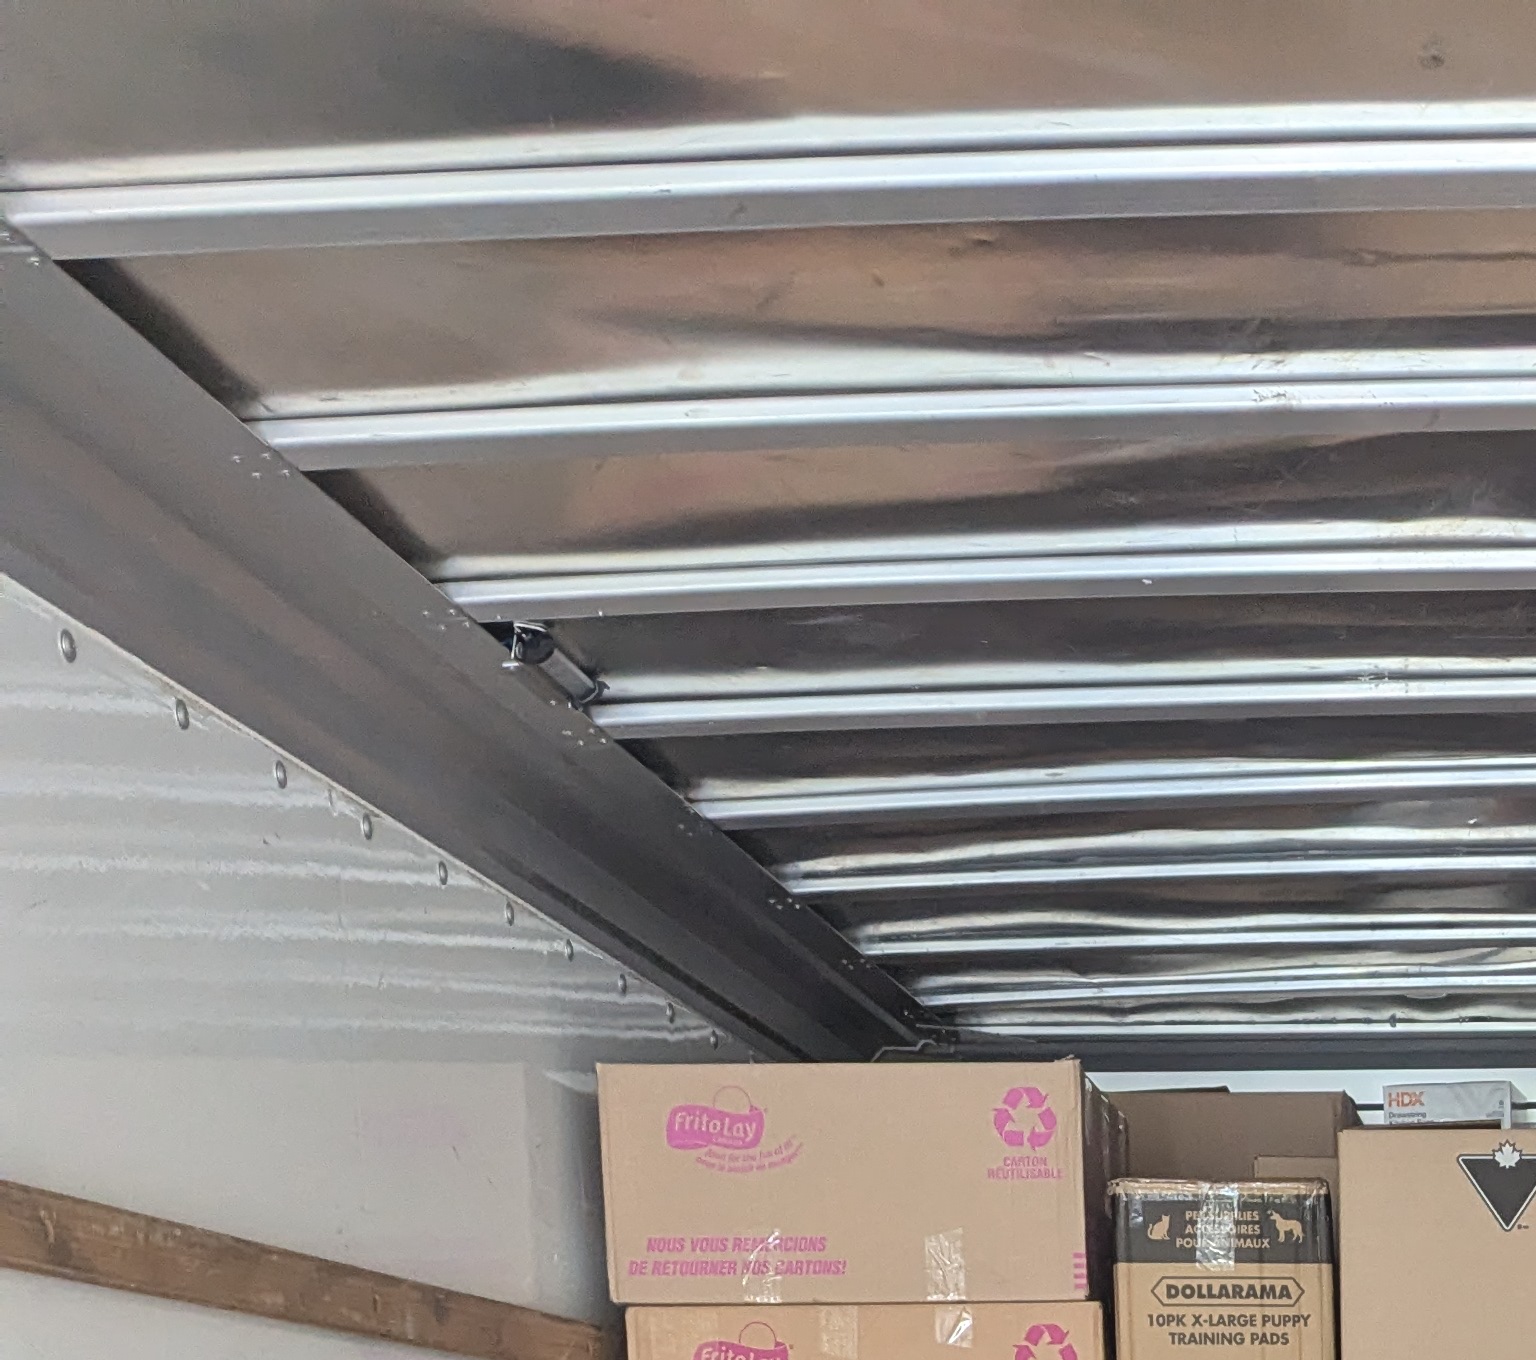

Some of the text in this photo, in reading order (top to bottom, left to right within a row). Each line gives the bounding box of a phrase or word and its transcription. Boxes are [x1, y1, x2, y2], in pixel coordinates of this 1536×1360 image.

[1388, 1091, 1425, 1107] HDX
[1003, 1156, 1048, 1167] CARTON
[647, 1237, 685, 1252] NOUS
[691, 1237, 728, 1252] VOUS
[629, 1259, 847, 1275] DE RETOURNER NOS CARTONS!
[1166, 1284, 1292, 1299] DOLLARAMA
[1148, 1314, 1311, 1328] 10PK X-LARGE PUPPY
[1169, 1332, 1289, 1345] TRAINING PADS
